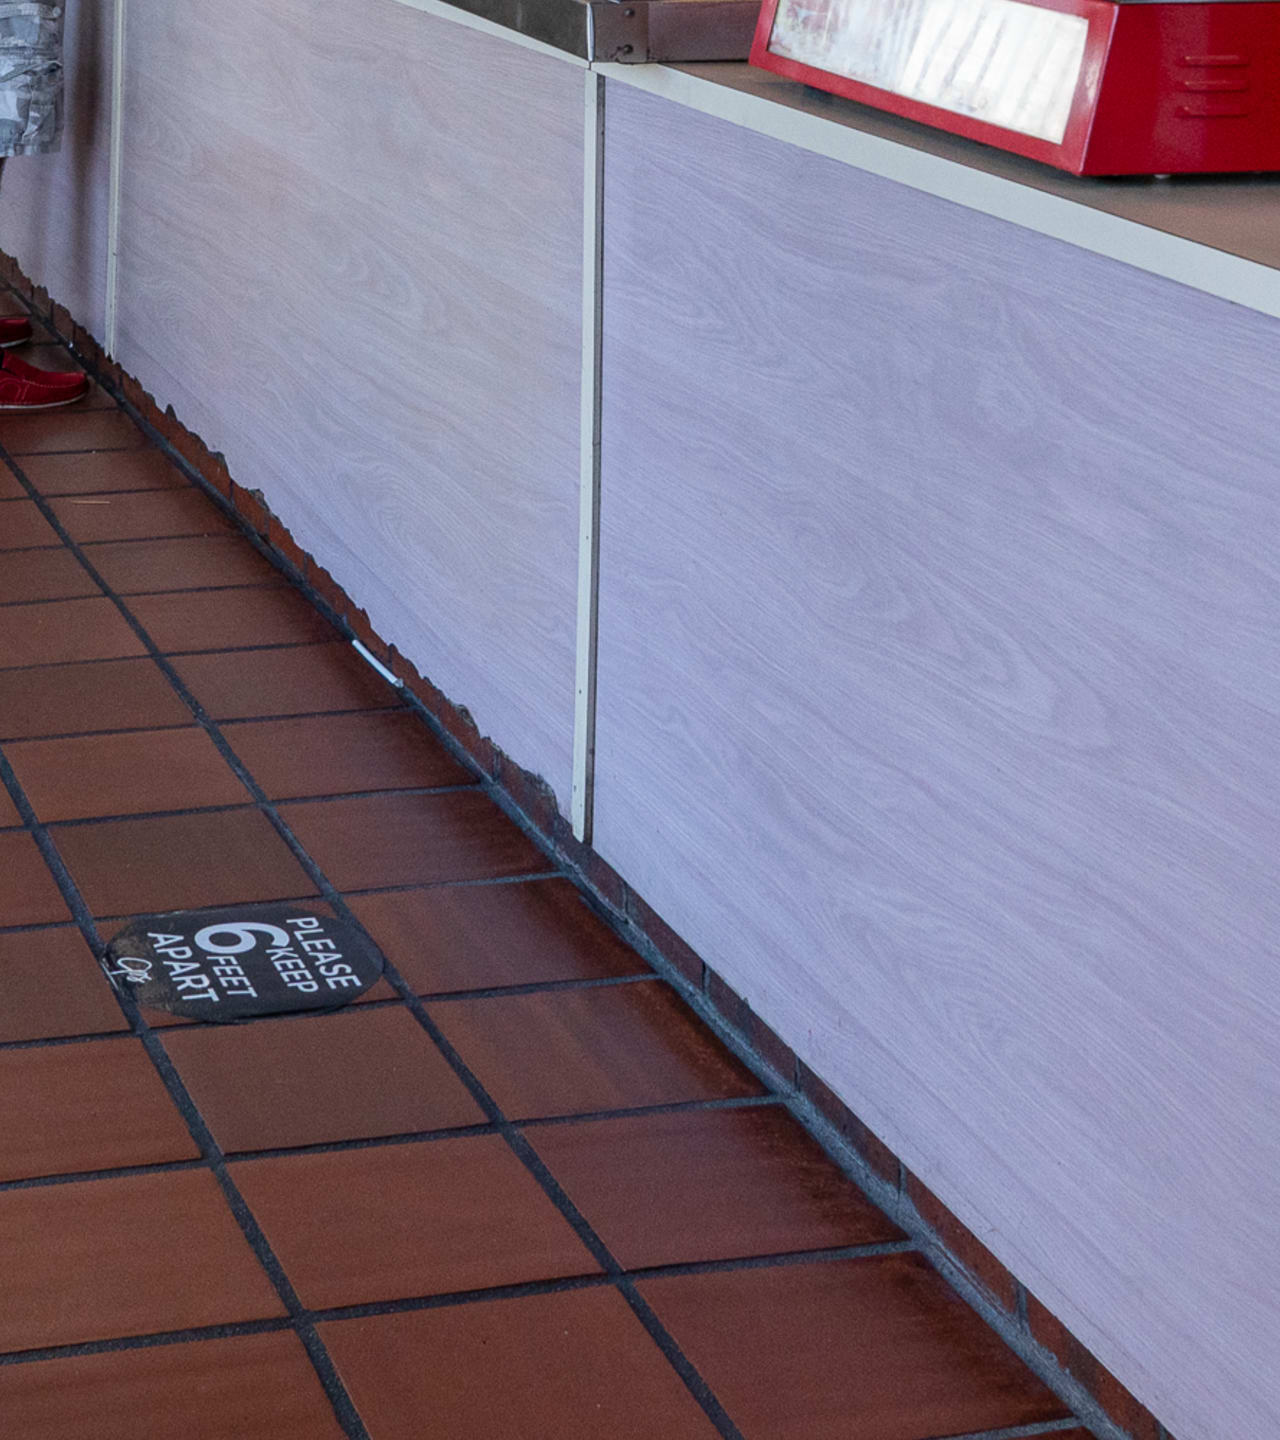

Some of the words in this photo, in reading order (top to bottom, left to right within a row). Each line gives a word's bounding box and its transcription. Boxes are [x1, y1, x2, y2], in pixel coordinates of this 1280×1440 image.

[194, 922, 290, 954] 6
[286, 917, 362, 989] PLEASE
[147, 932, 219, 1002] APART
[206, 955, 258, 998] FEET
[265, 946, 319, 993] KEEP
